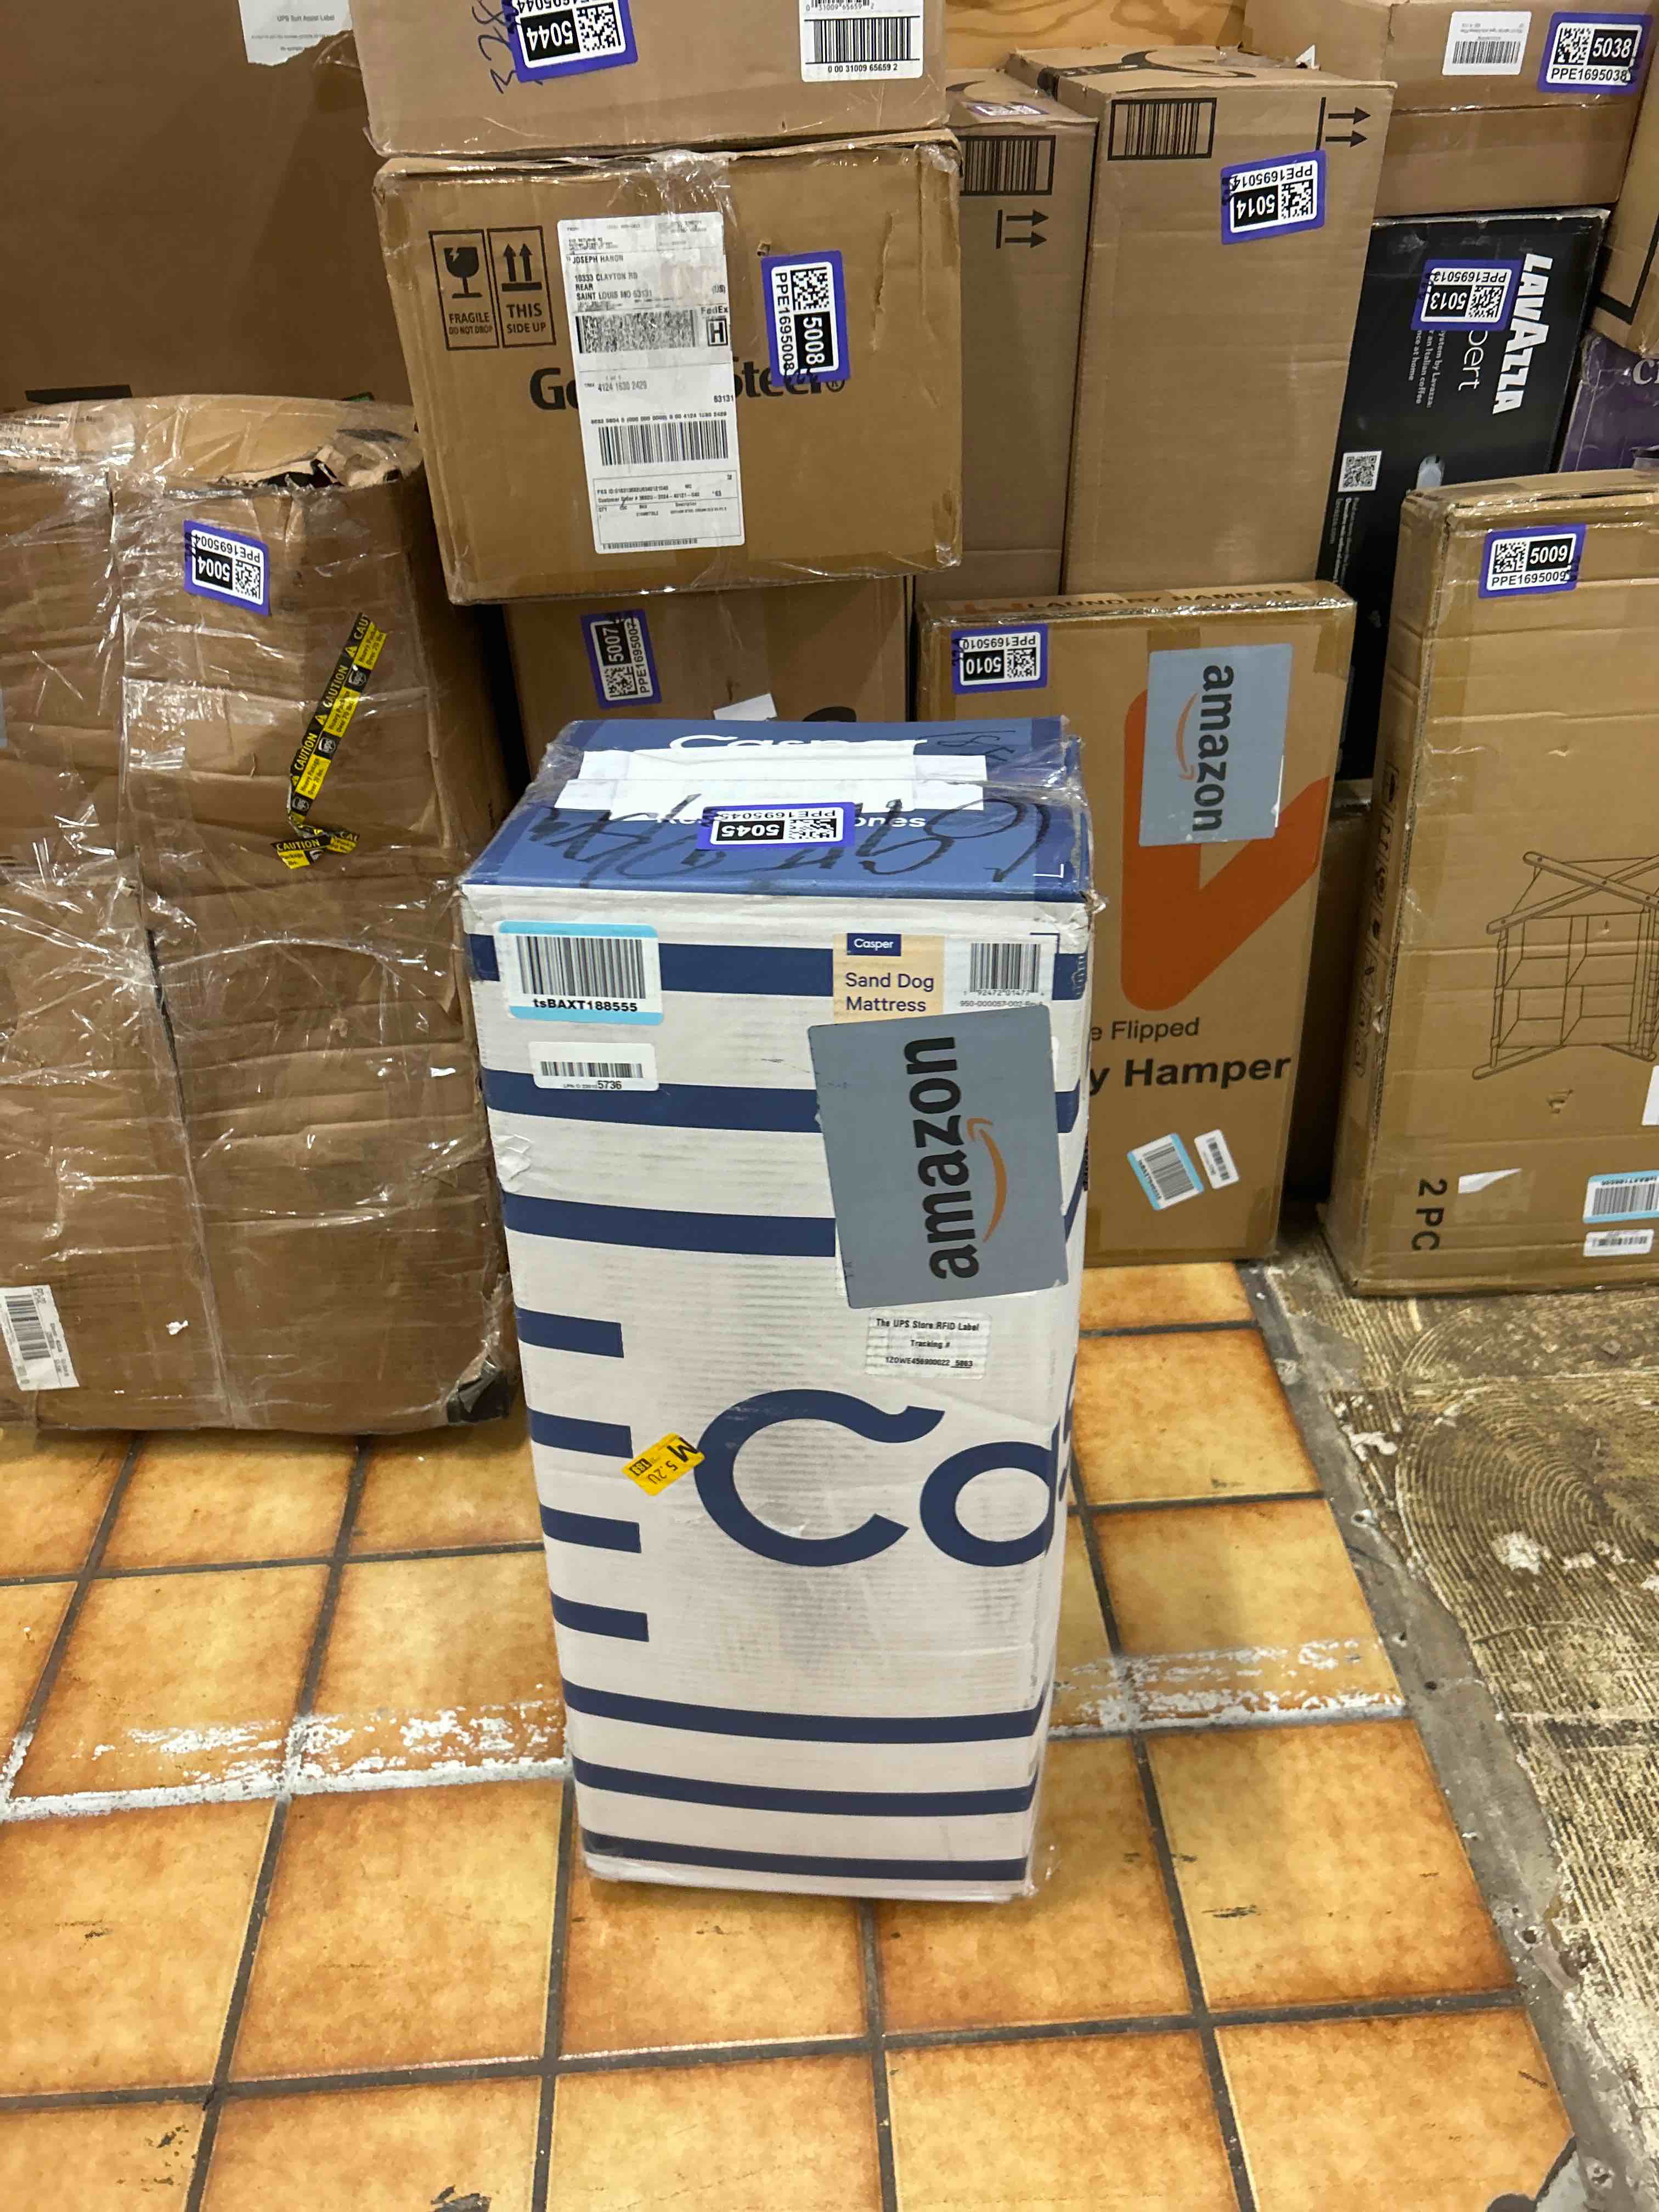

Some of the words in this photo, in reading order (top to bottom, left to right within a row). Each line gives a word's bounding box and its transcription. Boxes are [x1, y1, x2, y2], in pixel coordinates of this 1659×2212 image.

[526, 21, 574, 52] 5044
[1593, 37, 1632, 58] 5038
[834, 65, 844, 73] 00
[845, 64, 867, 72] 31009
[869, 63, 891, 72] 65659
[1551, 67, 1629, 82] PPE1695038
[1234, 164, 1313, 191] PPE1695014
[1236, 194, 1276, 219] 5014
[572, 255, 599, 264] JOSEPH
[596, 272, 626, 281] CLAYTON
[1433, 271, 1506, 283] PPE1695013
[575, 283, 594, 292] REAR
[576, 292, 596, 301] SAINT
[599, 291, 619, 300] LOUIS
[1430, 292, 1468, 310] 5013
[448, 312, 490, 324] FRAGILE
[505, 302, 543, 319] THIS
[701, 305, 729, 315] FedEx
[448, 326, 459, 336] DO
[460, 325, 474, 335] NOT
[474, 324, 493, 335] DROP
[506, 323, 531, 334] SIDE
[532, 321, 547, 333] UP
[775, 273, 795, 371] PPE1695008
[802, 317, 826, 365] 5008
[1492, 253, 1554, 415] LAVAZZA
[597, 382, 613, 392] 4124
[195, 533, 260, 563] PPE1695004
[1529, 545, 1568, 565] 5009
[198, 556, 230, 583] 5004
[1491, 571, 1567, 587] PPE1695009
[602, 627, 624, 662] 5007
[963, 635, 1036, 650] PPE1695010
[627, 622, 650, 693] PPE1695007
[966, 657, 1002, 675] 5010
[322, 664, 349, 708] CAUTION
[294, 732, 318, 771] CAUTION
[1192, 665, 1234, 832] amazon
[720, 810, 836, 820] PPE1695045
[721, 824, 780, 837] 5045
[276, 838, 320, 851] CAUTION
[854, 938, 894, 952] Casper
[845, 972, 891, 989] Sand
[898, 973, 935, 992] Dog
[533, 998, 637, 1012] tsBAXT188555
[846, 996, 927, 1012] Mattress
[1111, 1017, 1200, 1043] Flipped
[1124, 1057, 1292, 1090] Hamper
[597, 1080, 622, 1090] 5736
[904, 1036, 980, 1279] amazon
[1418, 1178, 1448, 1197] 2
[1411, 1207, 1445, 1251] PC
[876, 1318, 890, 1327] The
[893, 1319, 910, 1328] UPS
[912, 1321, 933, 1329] Store
[936, 1321, 956, 1330] RFID
[958, 1322, 980, 1331] Label
[911, 1339, 943, 1350] Tracking
[667, 1437, 699, 1463] M
